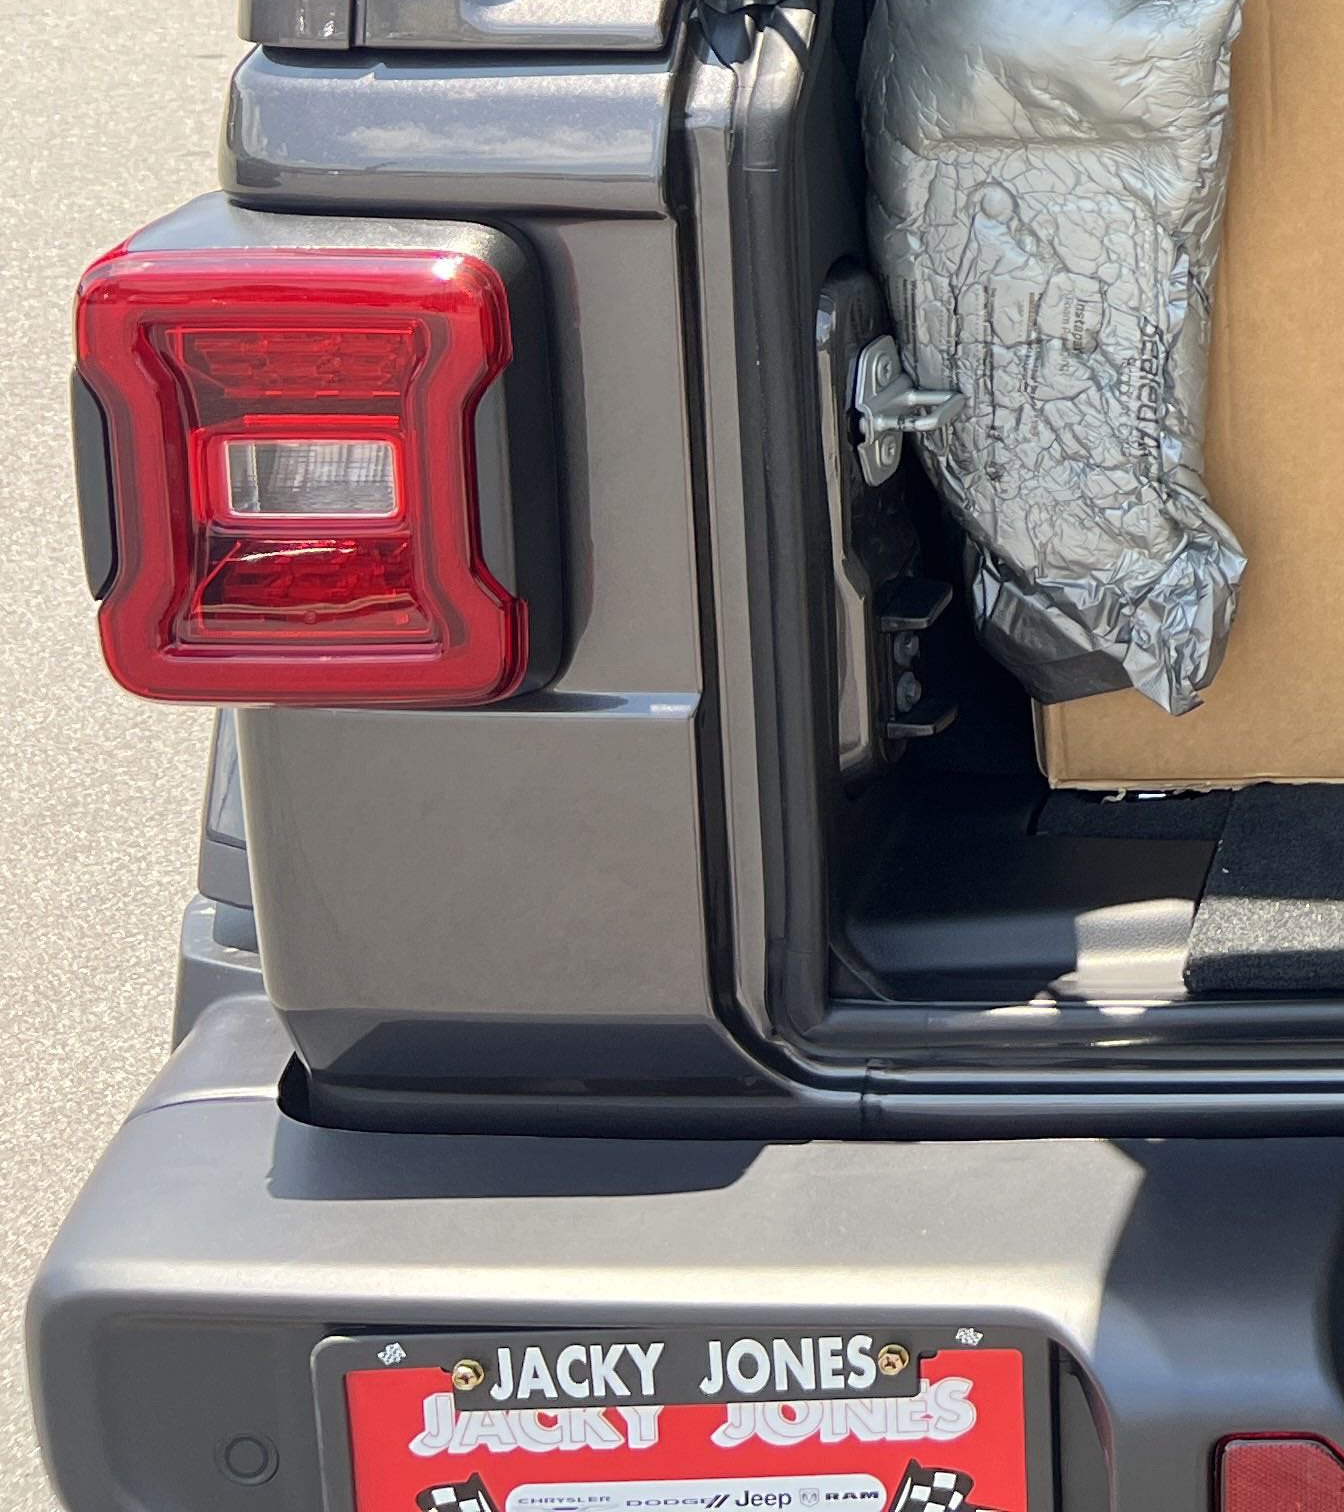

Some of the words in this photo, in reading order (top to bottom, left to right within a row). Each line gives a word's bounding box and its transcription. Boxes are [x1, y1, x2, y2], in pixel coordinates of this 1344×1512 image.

[490, 1342, 665, 1401] JACKY
[699, 1334, 877, 1395] JONES
[517, 1495, 612, 1506] CHRYSLER
[734, 1489, 793, 1508] Jeep
[824, 1490, 880, 1501] RAM
